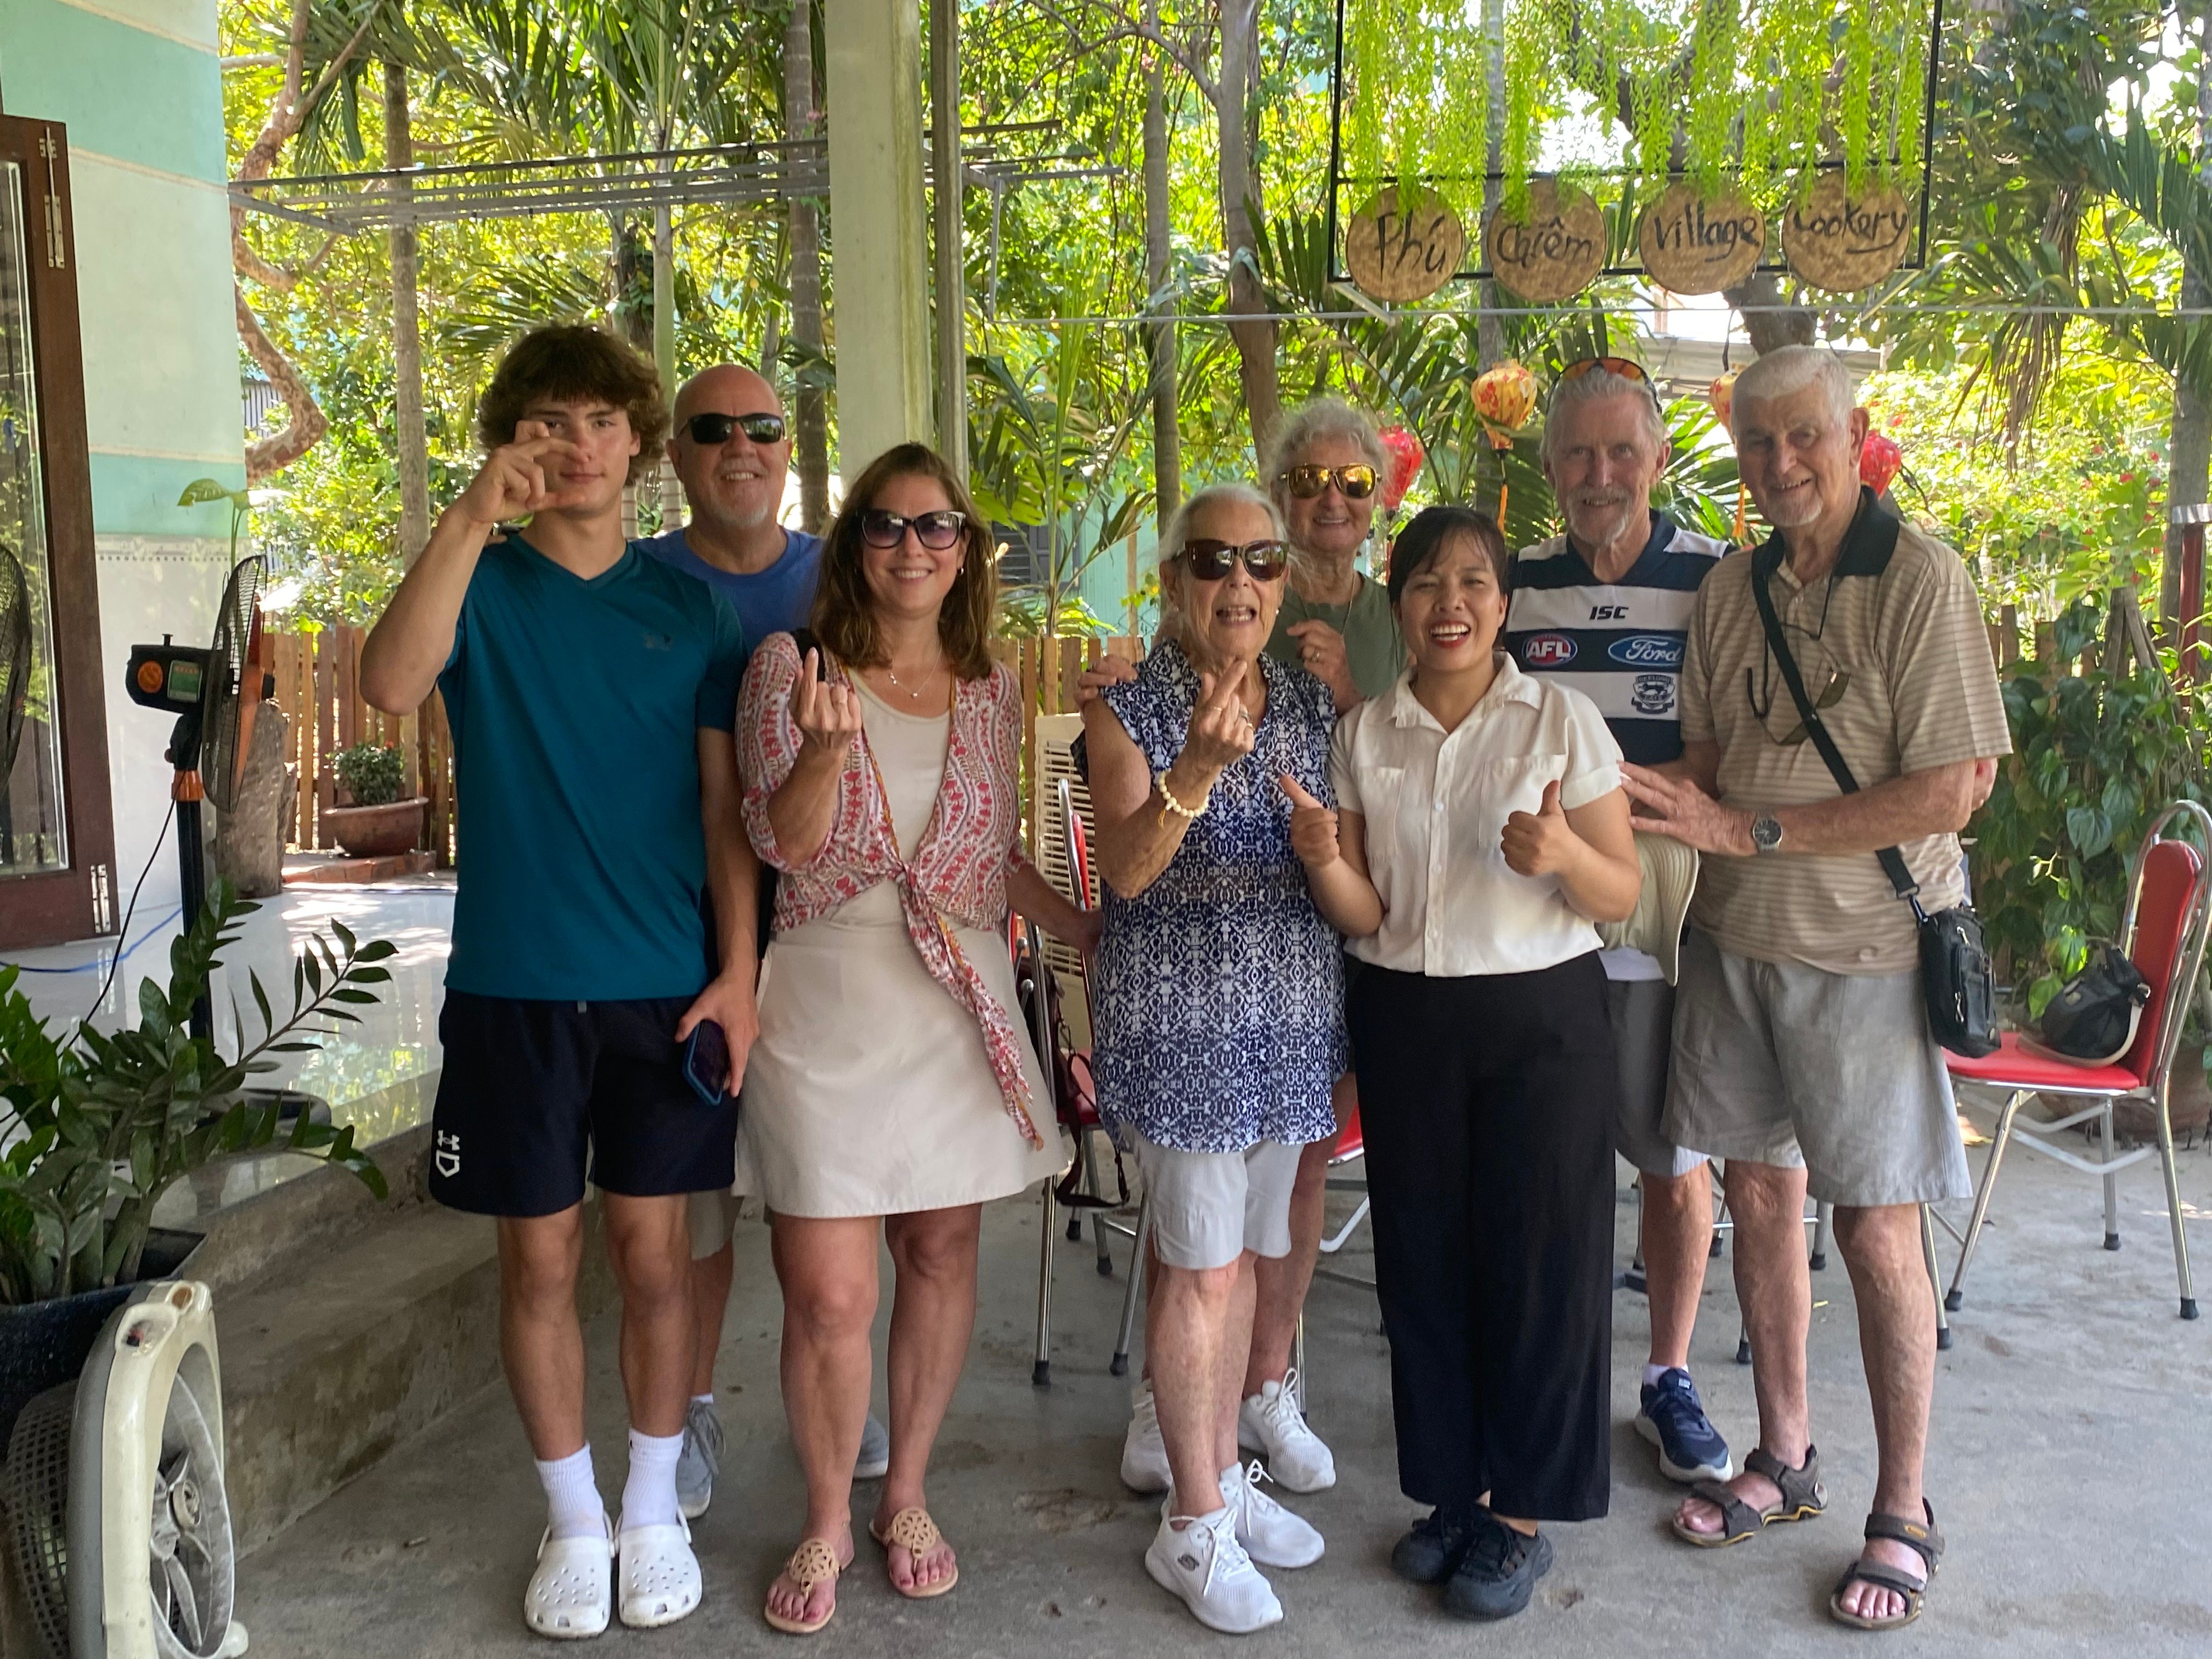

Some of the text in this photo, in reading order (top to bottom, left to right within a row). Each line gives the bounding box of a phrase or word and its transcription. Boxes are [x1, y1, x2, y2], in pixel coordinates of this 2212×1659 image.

[1375, 210, 1446, 283] Phú
[1654, 200, 1760, 262] Village
[1589, 606, 1629, 620] ISC
[1526, 641, 1571, 658] AFL
[1626, 639, 1680, 662] Ford
